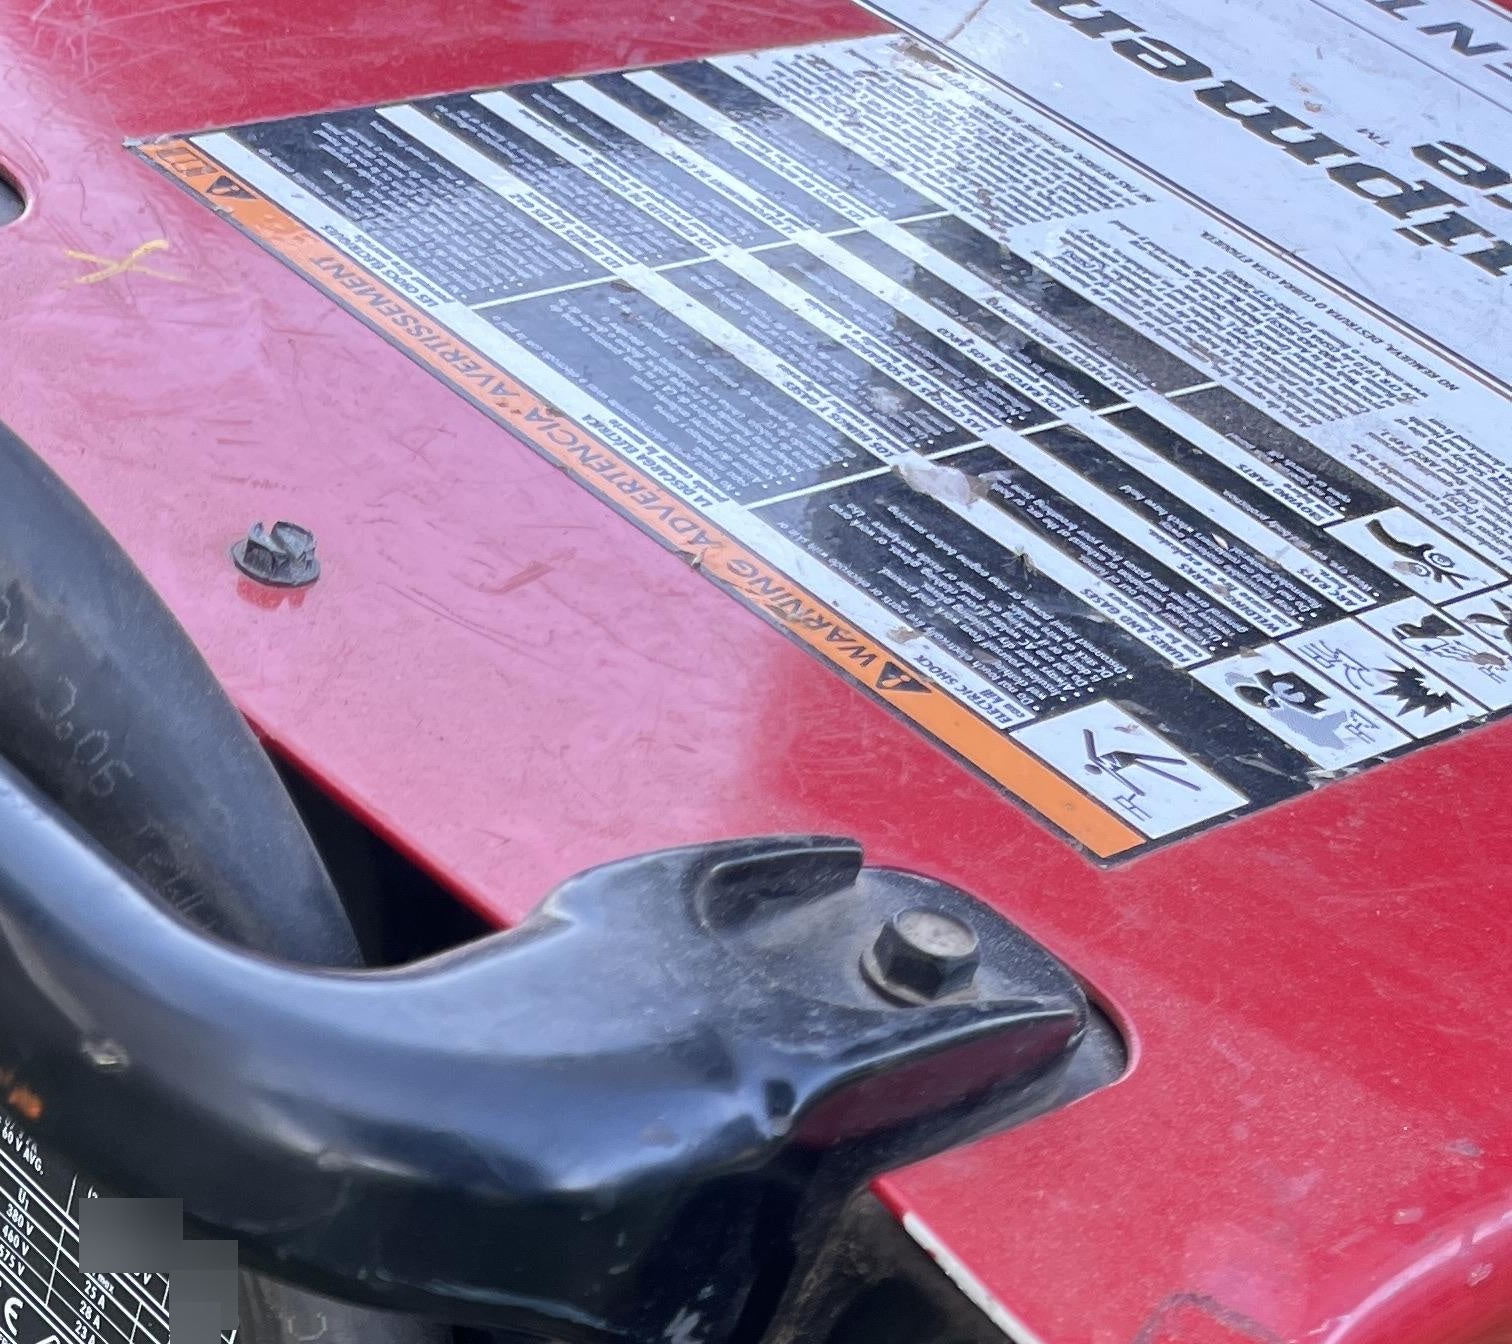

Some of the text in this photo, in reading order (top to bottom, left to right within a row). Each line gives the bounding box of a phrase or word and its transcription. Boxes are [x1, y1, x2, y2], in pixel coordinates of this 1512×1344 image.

[310, 256, 517, 395] AVERTISSEMENT
[1079, 588, 1120, 614] GASES
[1296, 567, 1357, 606] ARC RAYS
[728, 565, 877, 666] WARNING
[1119, 614, 1149, 633] AND
[1223, 594, 1279, 632] WELDING
[913, 654, 1012, 723] ELECTRIC SHOCK
[15, 1137, 23, 1152] V
[22, 1147, 43, 1175] AVG.
[6, 1203, 34, 1236] 380 V
[1, 1224, 29, 1256] 460 V
[17, 1261, 25, 1276] V
[84, 1279, 105, 1310] 25 A
[74, 1320, 87, 1339] 23
[79, 1300, 100, 1330] 28 A
